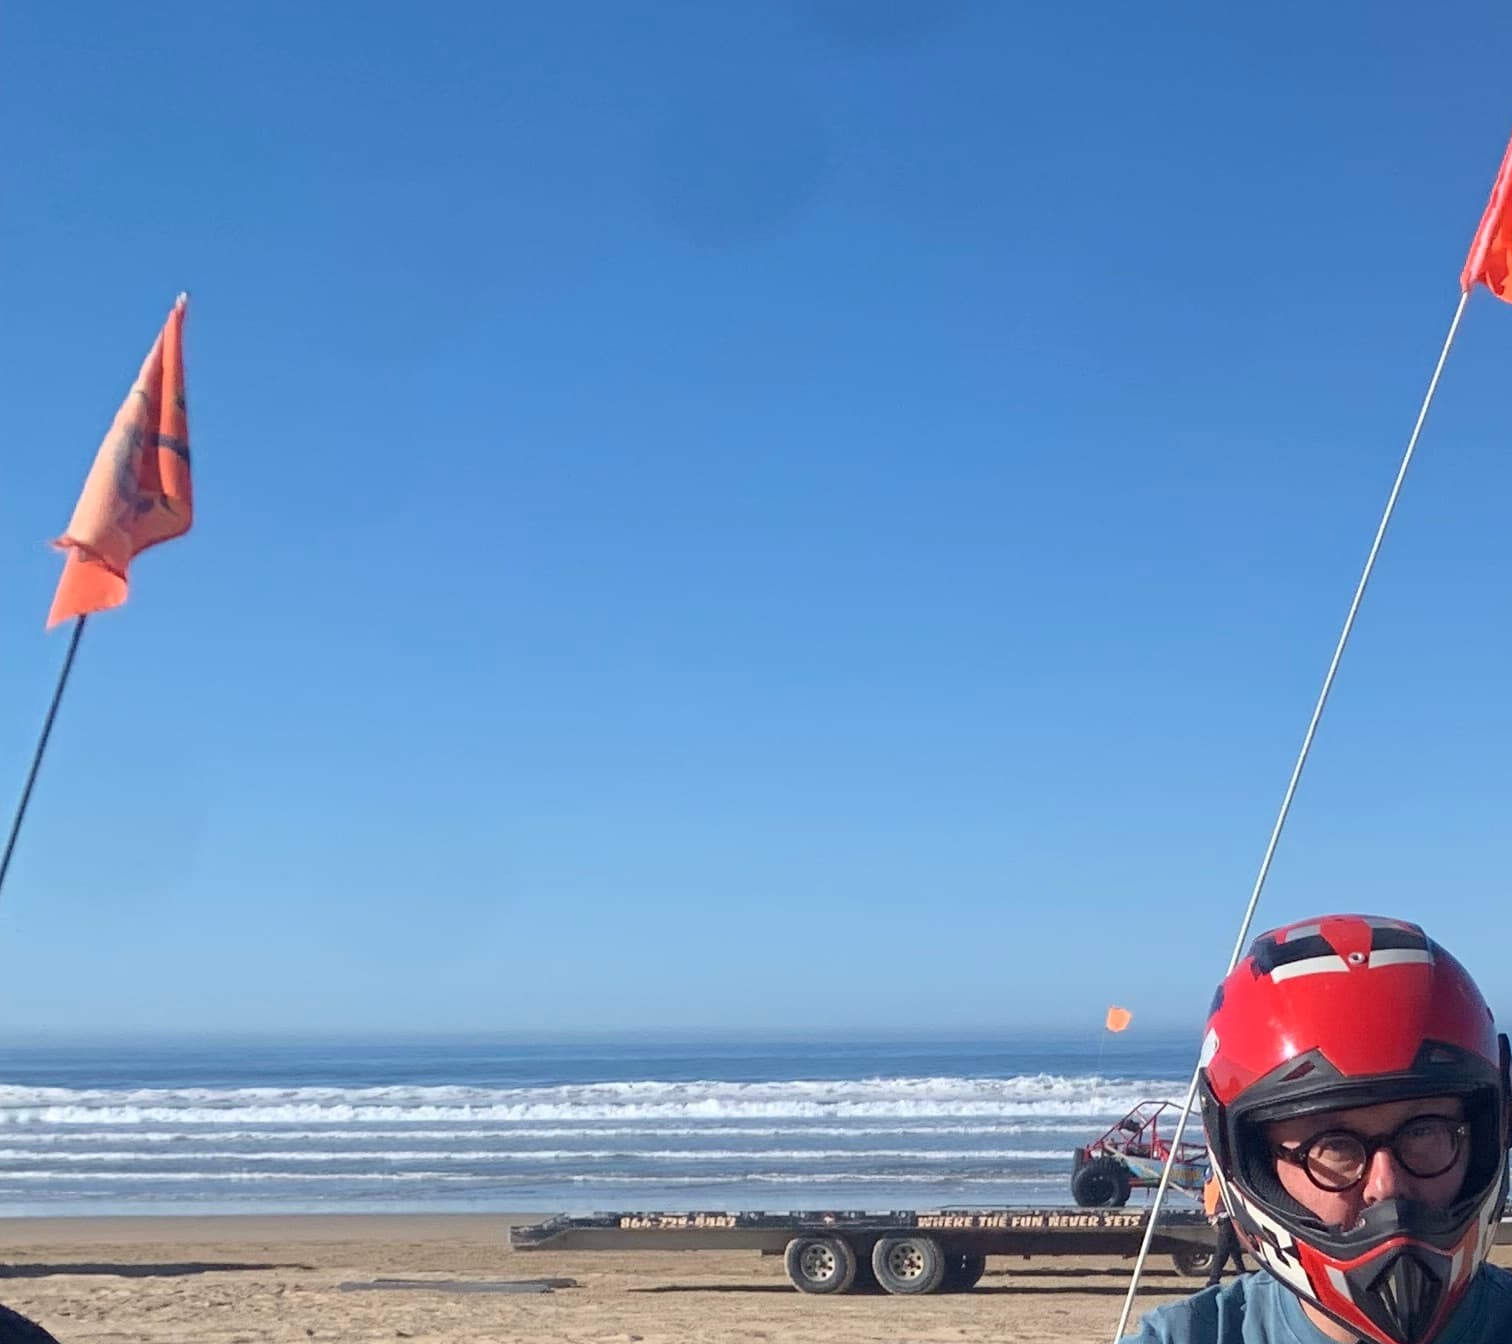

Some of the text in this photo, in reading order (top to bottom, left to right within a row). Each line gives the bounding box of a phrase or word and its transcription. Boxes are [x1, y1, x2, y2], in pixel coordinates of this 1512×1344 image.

[917, 1215, 1141, 1228] WHERE THE FUN NEVER SETS
